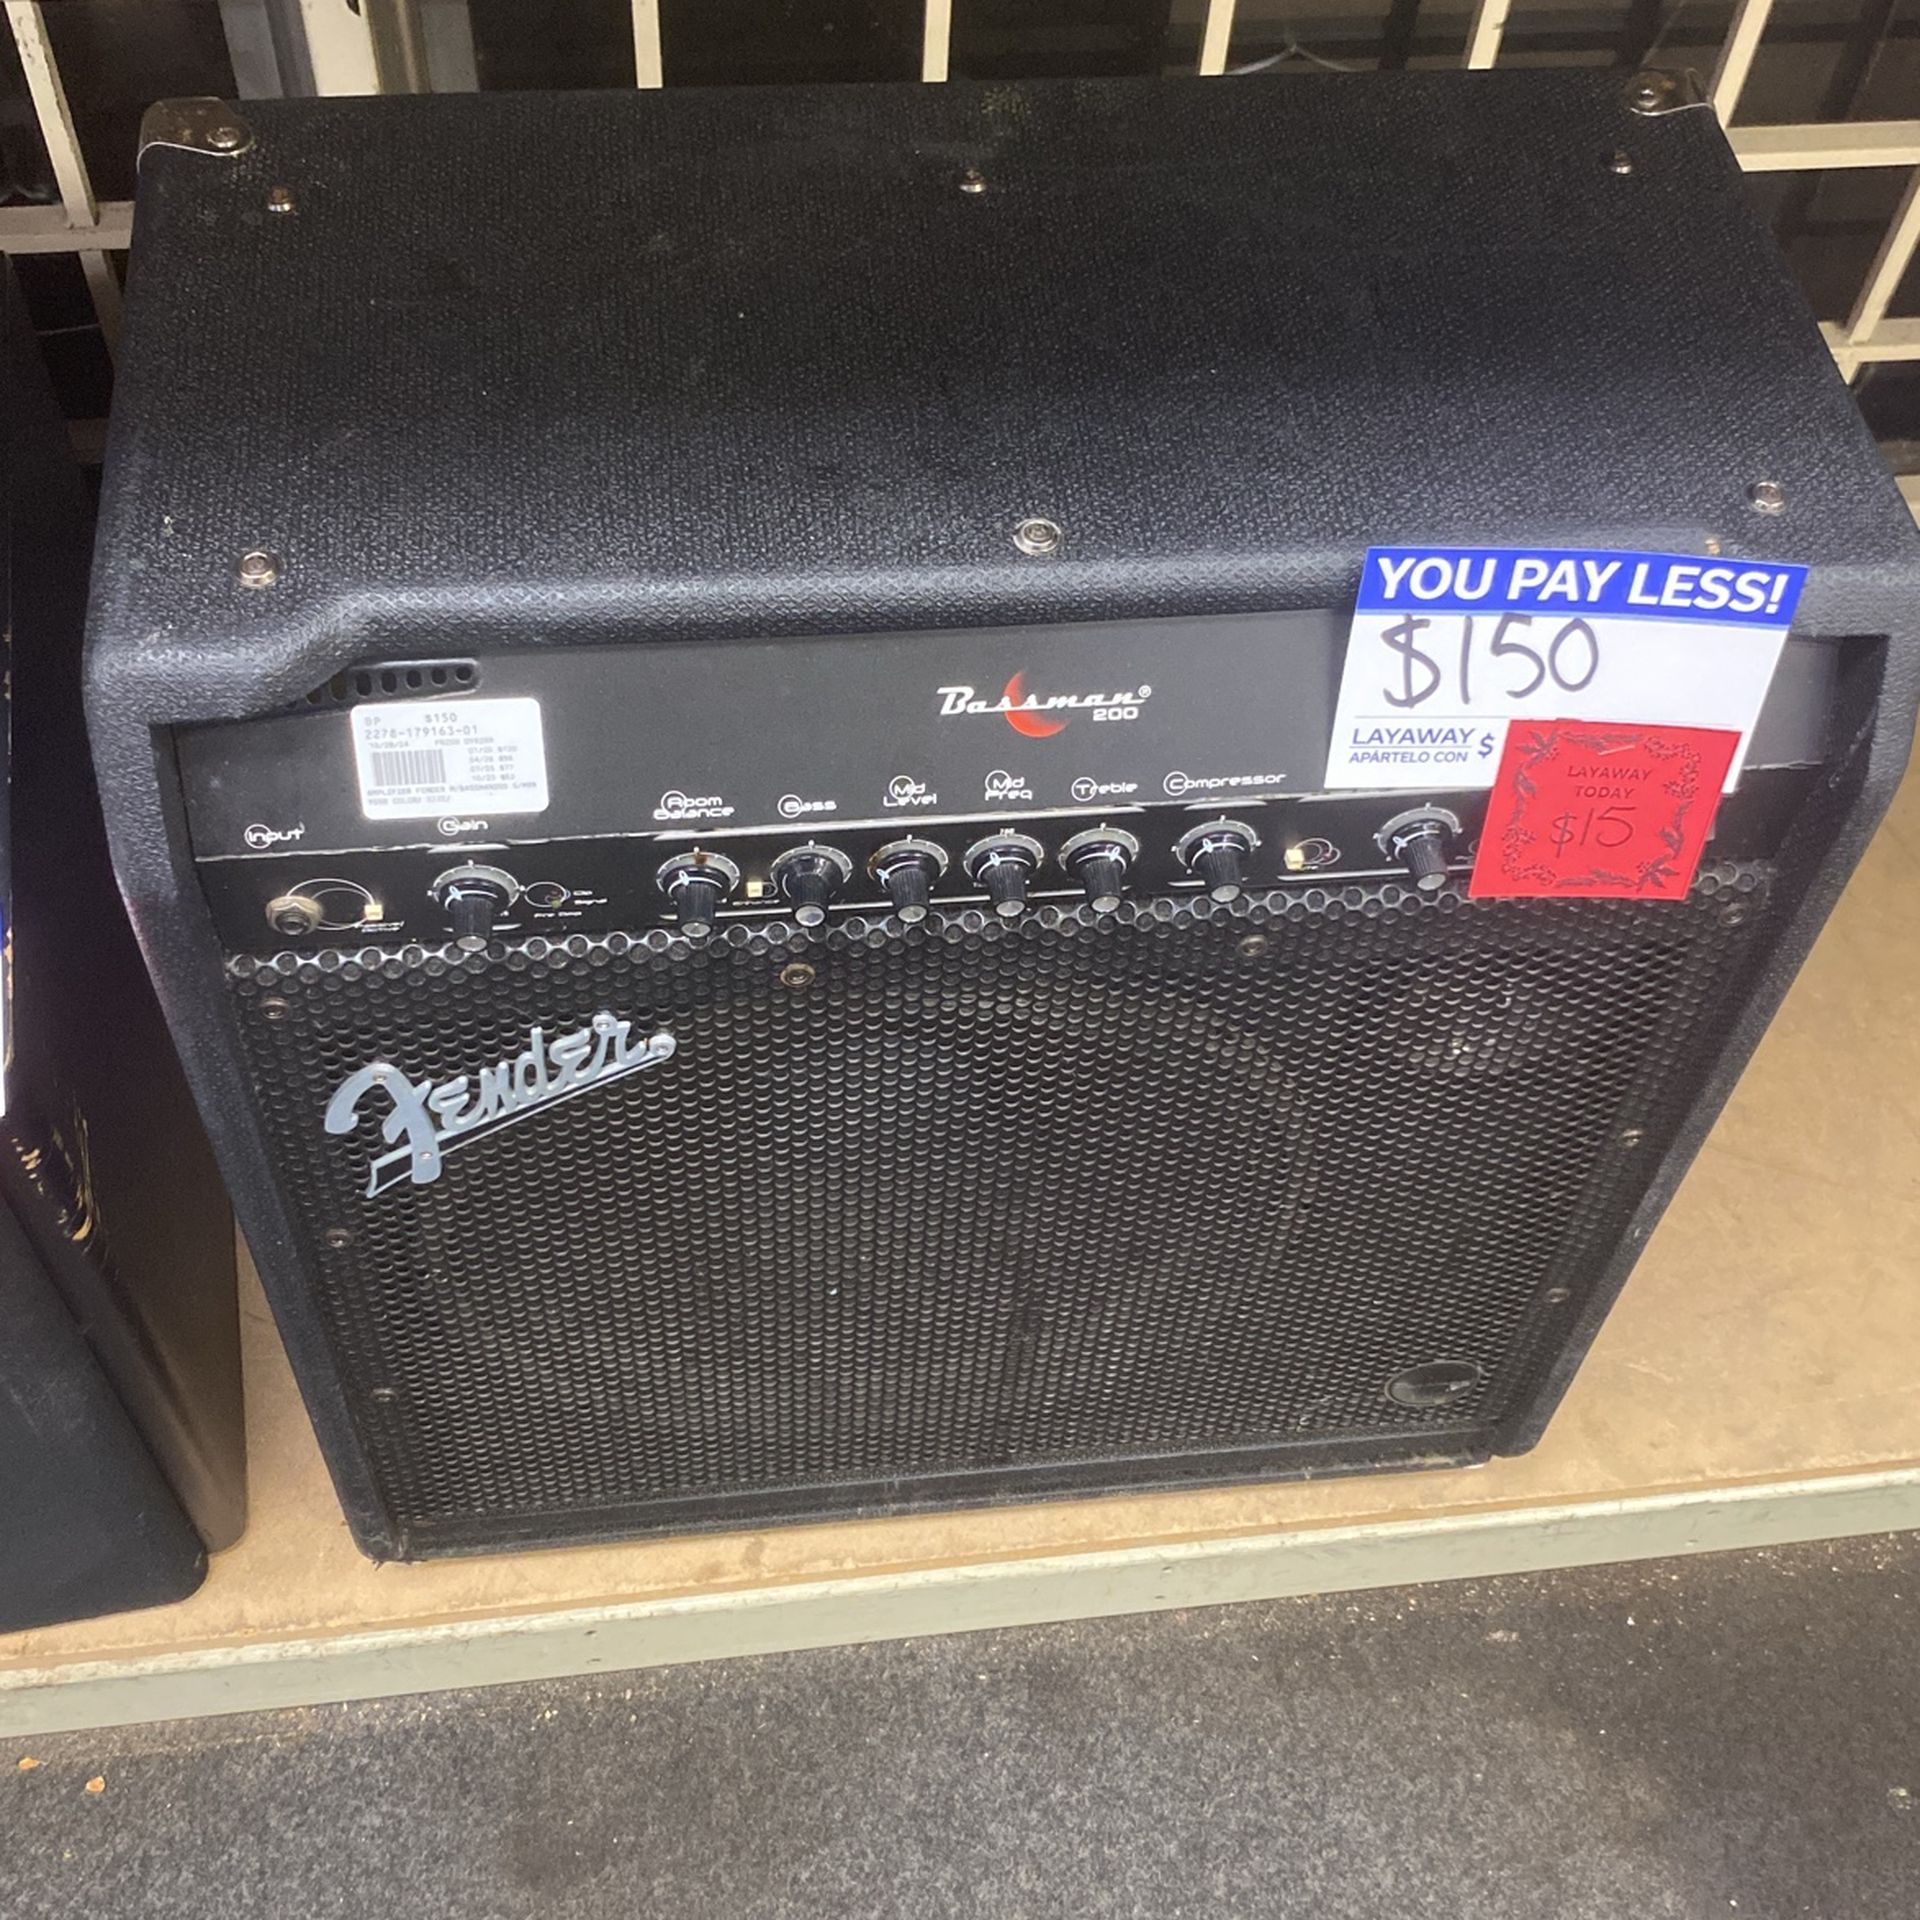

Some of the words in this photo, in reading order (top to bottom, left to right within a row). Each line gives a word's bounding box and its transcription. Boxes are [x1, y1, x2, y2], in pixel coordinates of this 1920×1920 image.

[1377, 557, 1499, 600] YOU
[1507, 559, 1622, 602] PAY
[1626, 565, 1788, 614] LESS!
[1381, 613, 1600, 709] $150
[425, 712, 458, 724] $150
[1092, 706, 1138, 722] 200
[1352, 727, 1477, 745] LAYAWAY
[1477, 732, 1496, 759] $
[1349, 749, 1431, 764] APÁRTELO
[1433, 750, 1469, 763] CON
[989, 773, 1026, 791] Mid
[1567, 765, 1655, 781] LAYAWAY
[892, 778, 926, 797] Mid
[1073, 779, 1139, 798] Treble
[1165, 772, 1287, 793] Compressor
[664, 793, 723, 809] Room
[883, 792, 938, 808] Level
[985, 788, 1033, 801] Freq
[1574, 785, 1636, 800] TODAY
[652, 804, 736, 821] Balance
[780, 796, 838, 816] Bass
[440, 818, 489, 833] Gain
[1549, 806, 1638, 858] $15
[246, 825, 304, 845] Input
[325, 1012, 677, 1196] Fender
